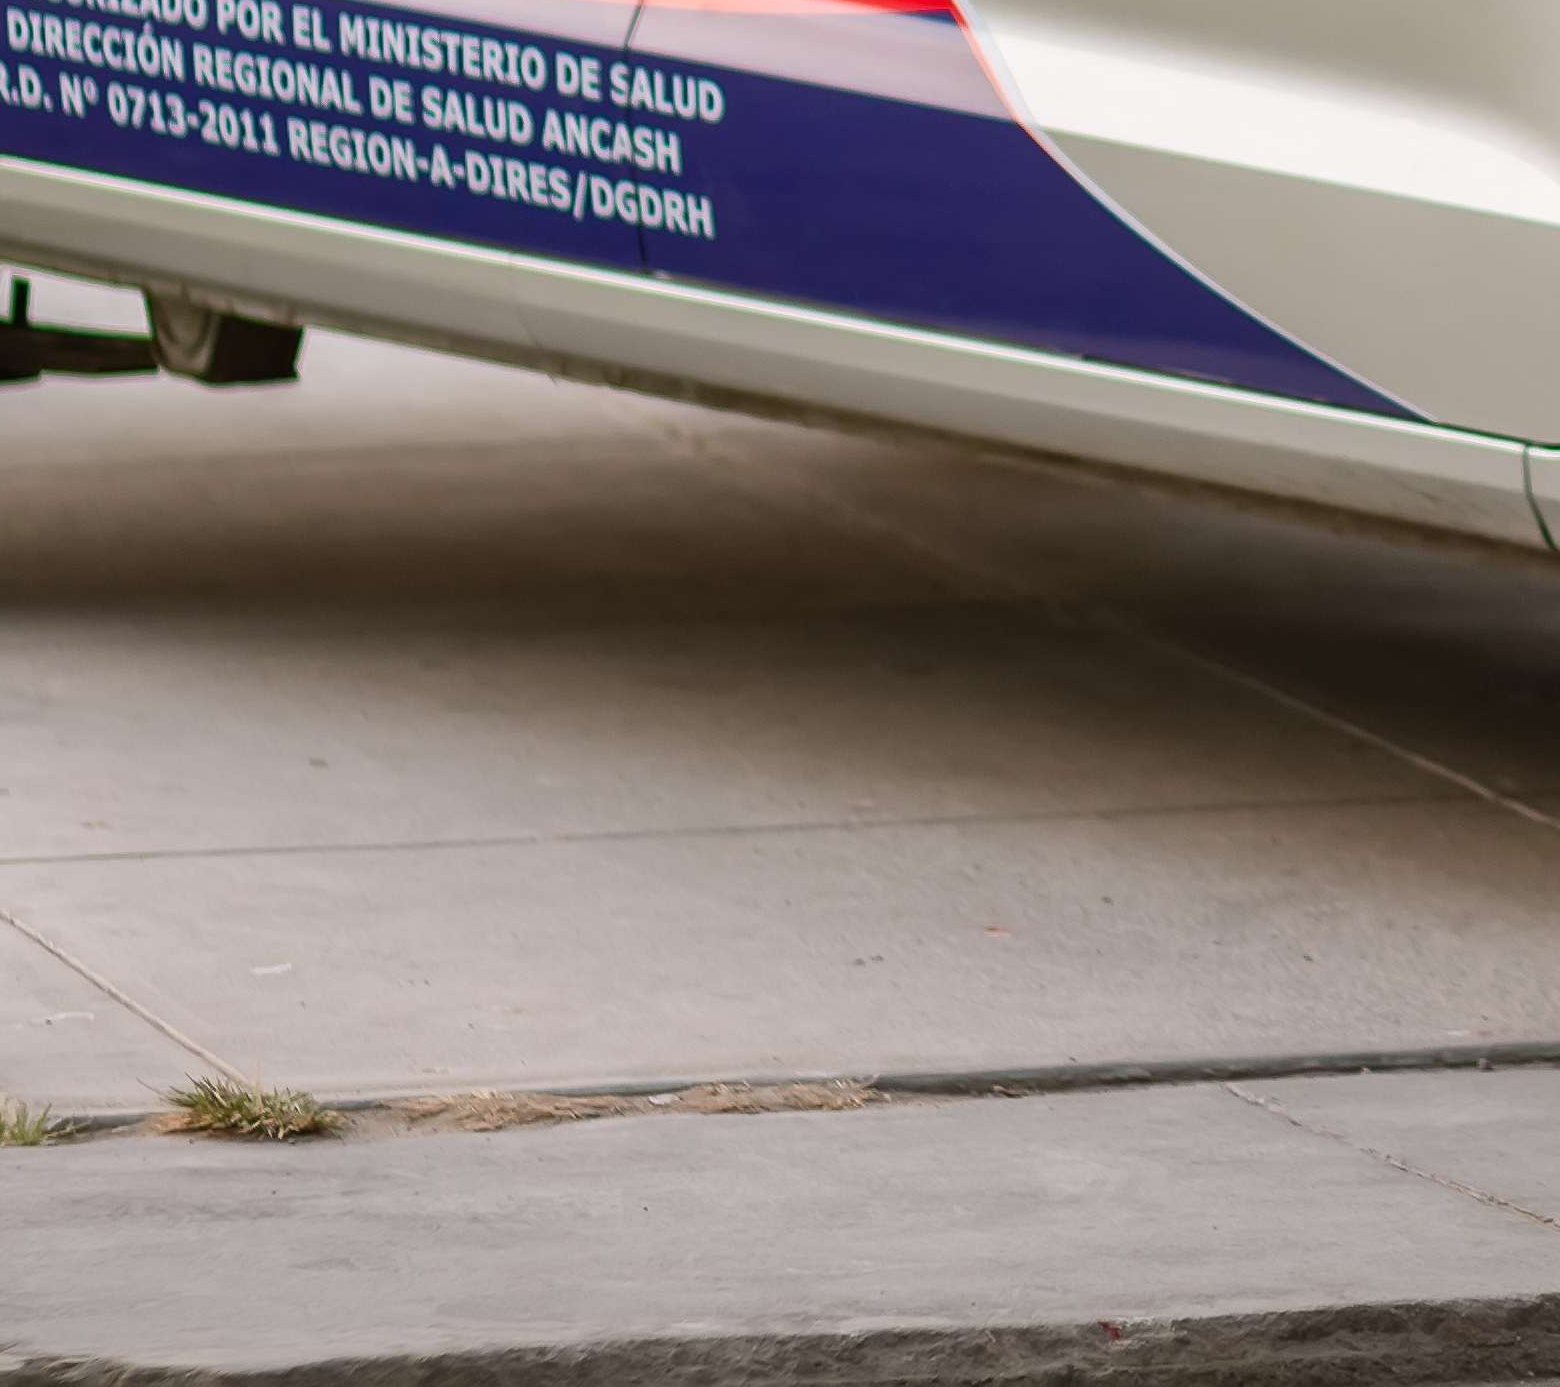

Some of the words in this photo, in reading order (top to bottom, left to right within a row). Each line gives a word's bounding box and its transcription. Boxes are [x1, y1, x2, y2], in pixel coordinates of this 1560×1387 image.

[6, 7, 186, 83] DIRECCIÓN
[194, 41, 362, 116] REGIONAL
[369, 75, 414, 120] DE
[421, 83, 533, 147] SALUD
[541, 106, 683, 176] ANCASH
[292, 4, 331, 53] EL
[339, 12, 547, 91] MINISTERIO
[556, 53, 602, 97] DE
[609, 62, 726, 124] SALUD
[107, 82, 280, 158] 0713-2011
[288, 119, 717, 240] REGION-A-DIRES/DGDRH
